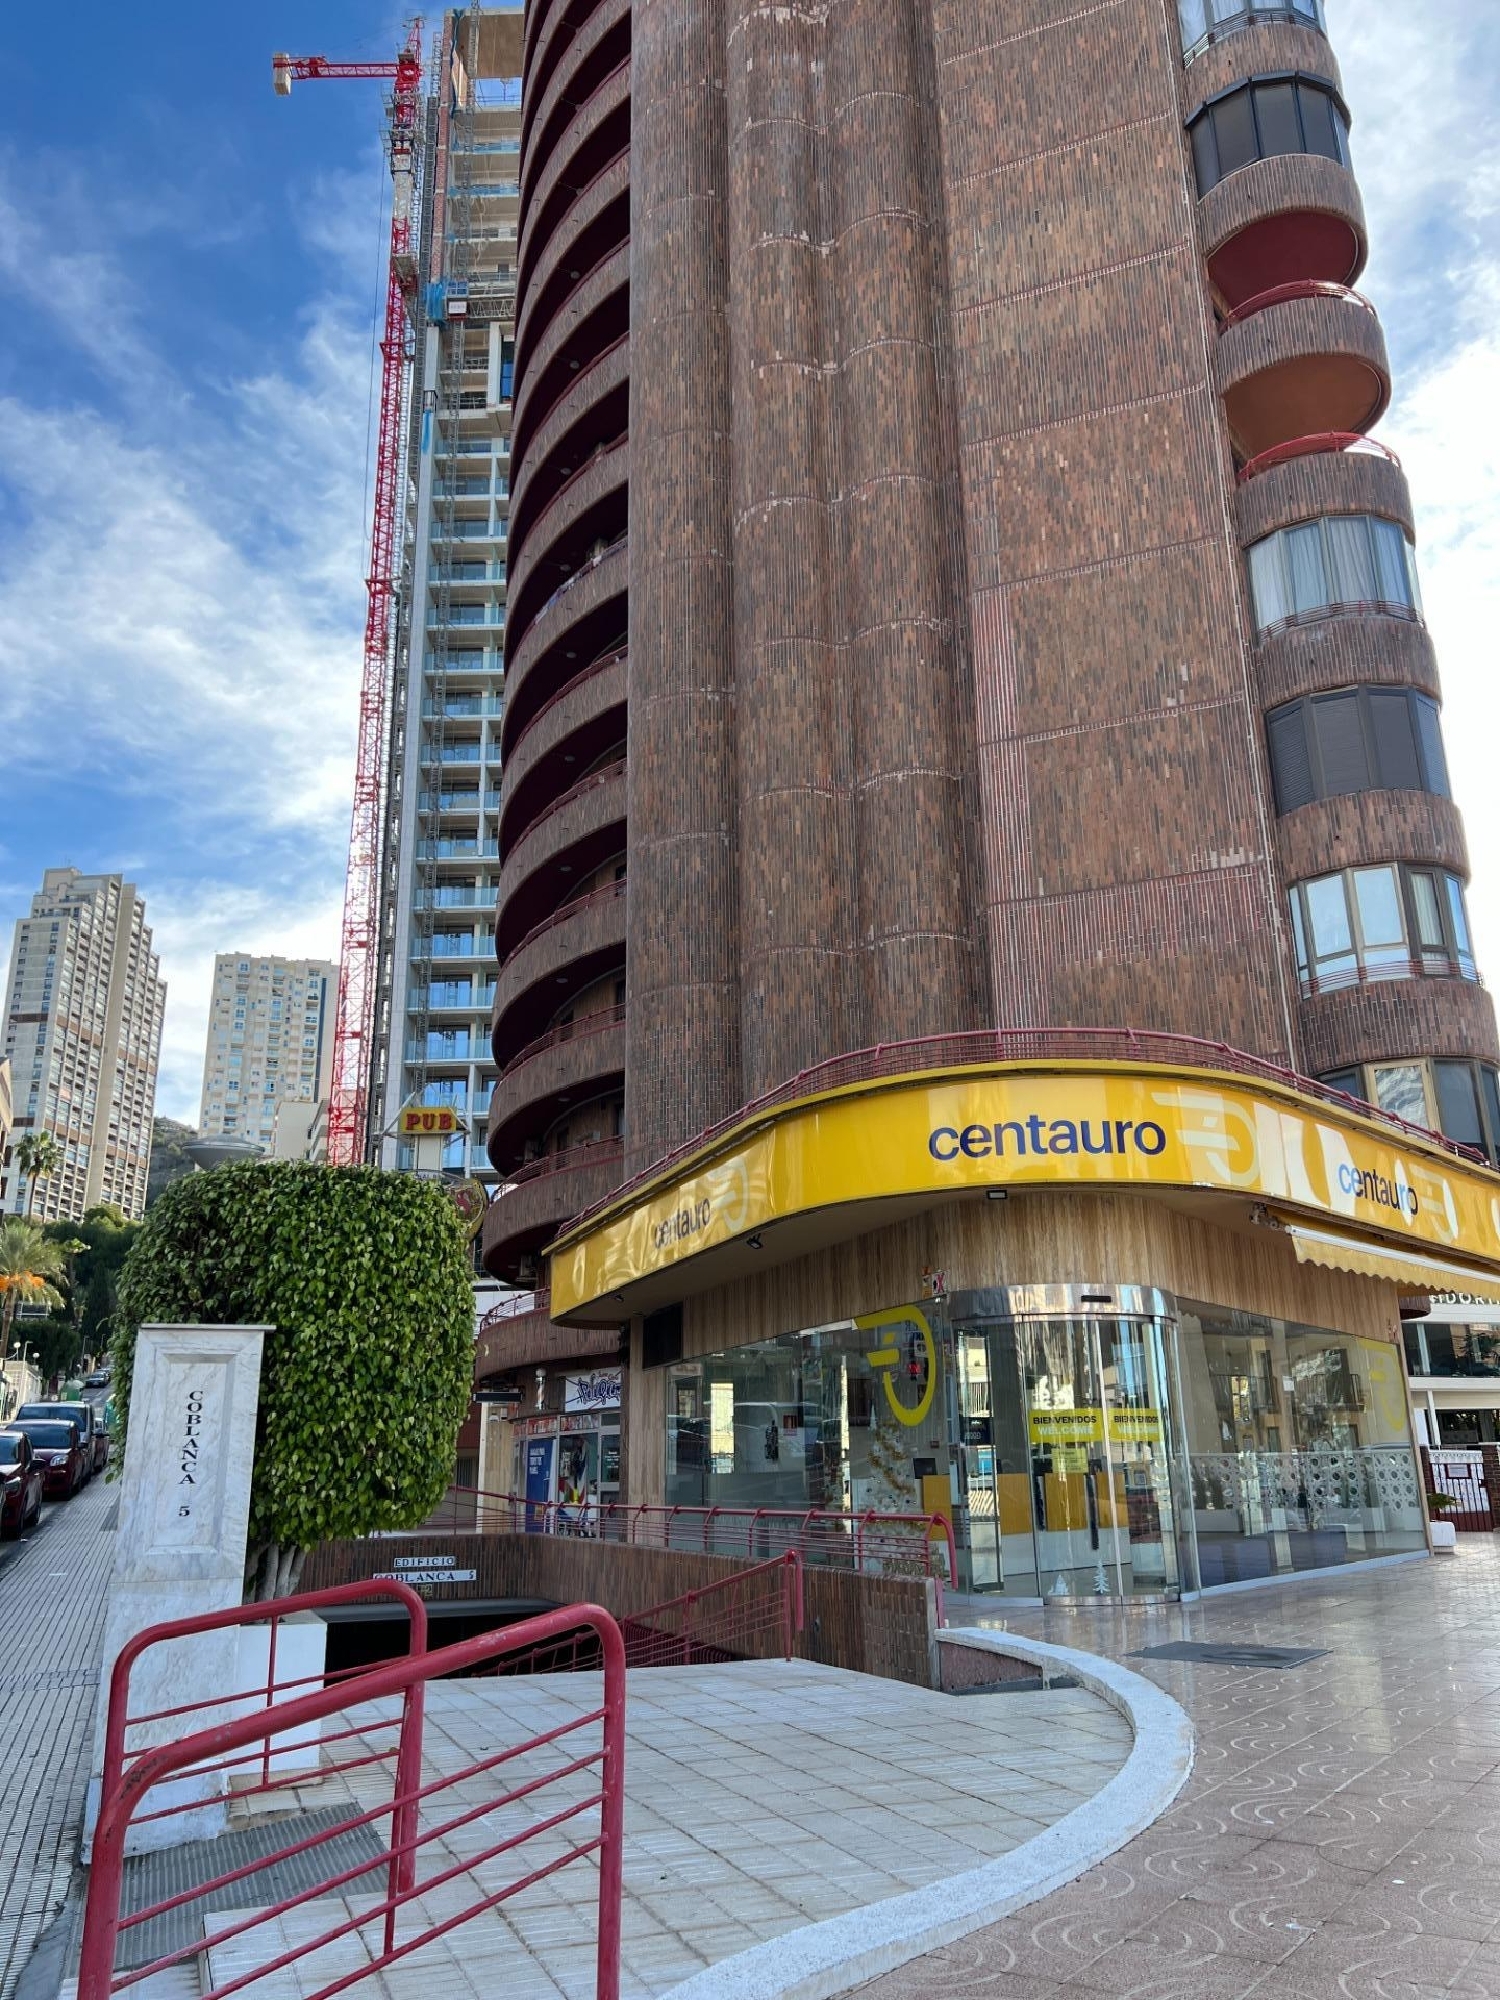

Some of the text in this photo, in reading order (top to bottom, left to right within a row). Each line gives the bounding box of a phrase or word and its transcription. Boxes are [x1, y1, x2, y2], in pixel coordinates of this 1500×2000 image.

[406, 1113, 452, 1131] PUB
[928, 1115, 1167, 1161] centauro
[1338, 1163, 1418, 1215] centauro
[654, 1198, 711, 1249] centauro
[1033, 1415, 1097, 1424] BIENVENIDOS
[178, 1390, 204, 1517] COBLANCA 5
[395, 1557, 455, 1567] EDIFICIO
[469, 1570, 474, 1580] 5
